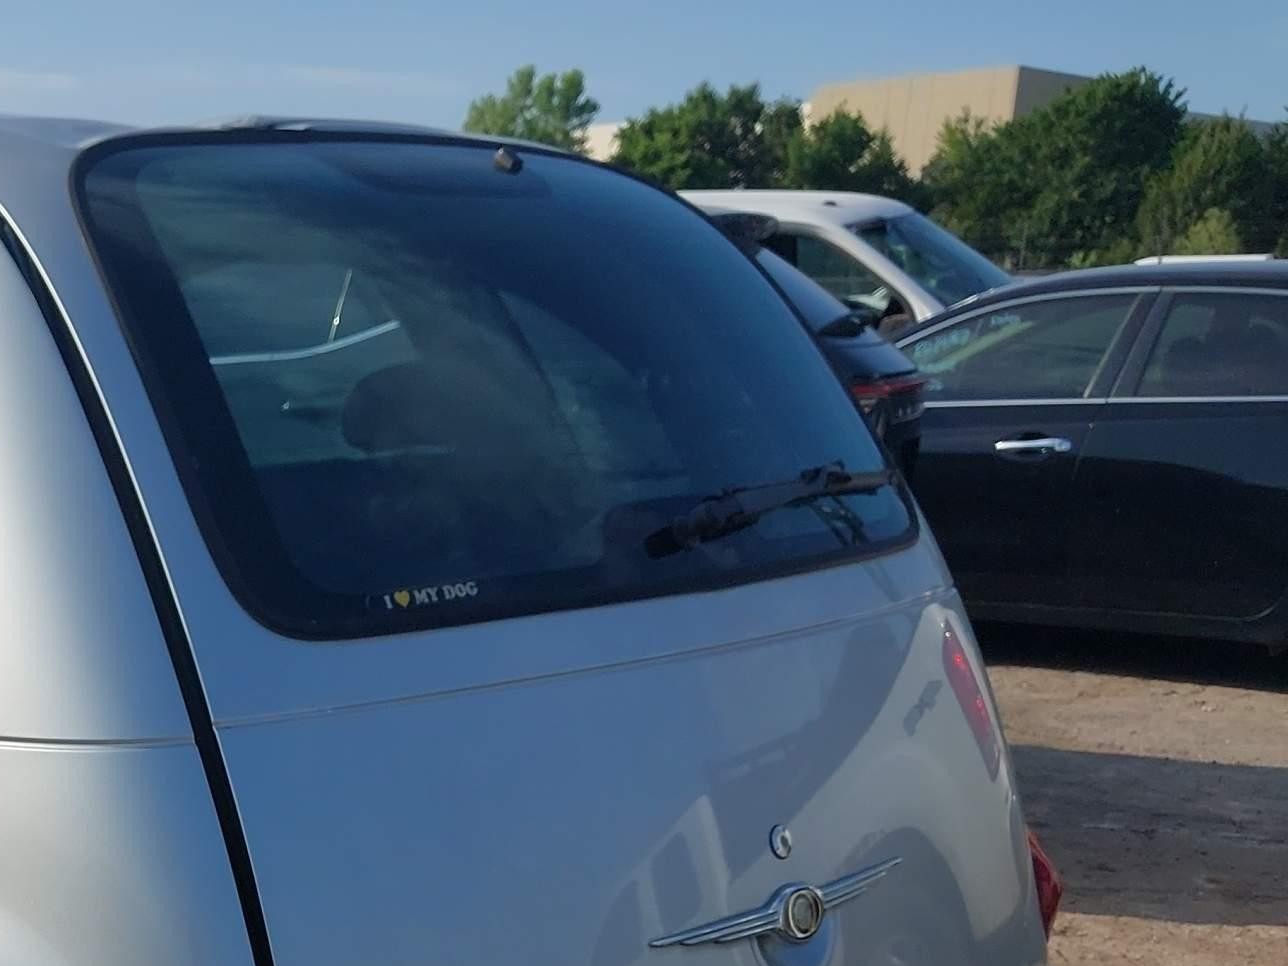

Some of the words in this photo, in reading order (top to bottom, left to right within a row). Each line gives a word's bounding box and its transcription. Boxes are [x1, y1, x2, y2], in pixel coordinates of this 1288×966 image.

[383, 594, 393, 609] I
[413, 586, 439, 605] MY
[442, 581, 479, 600] DOG
